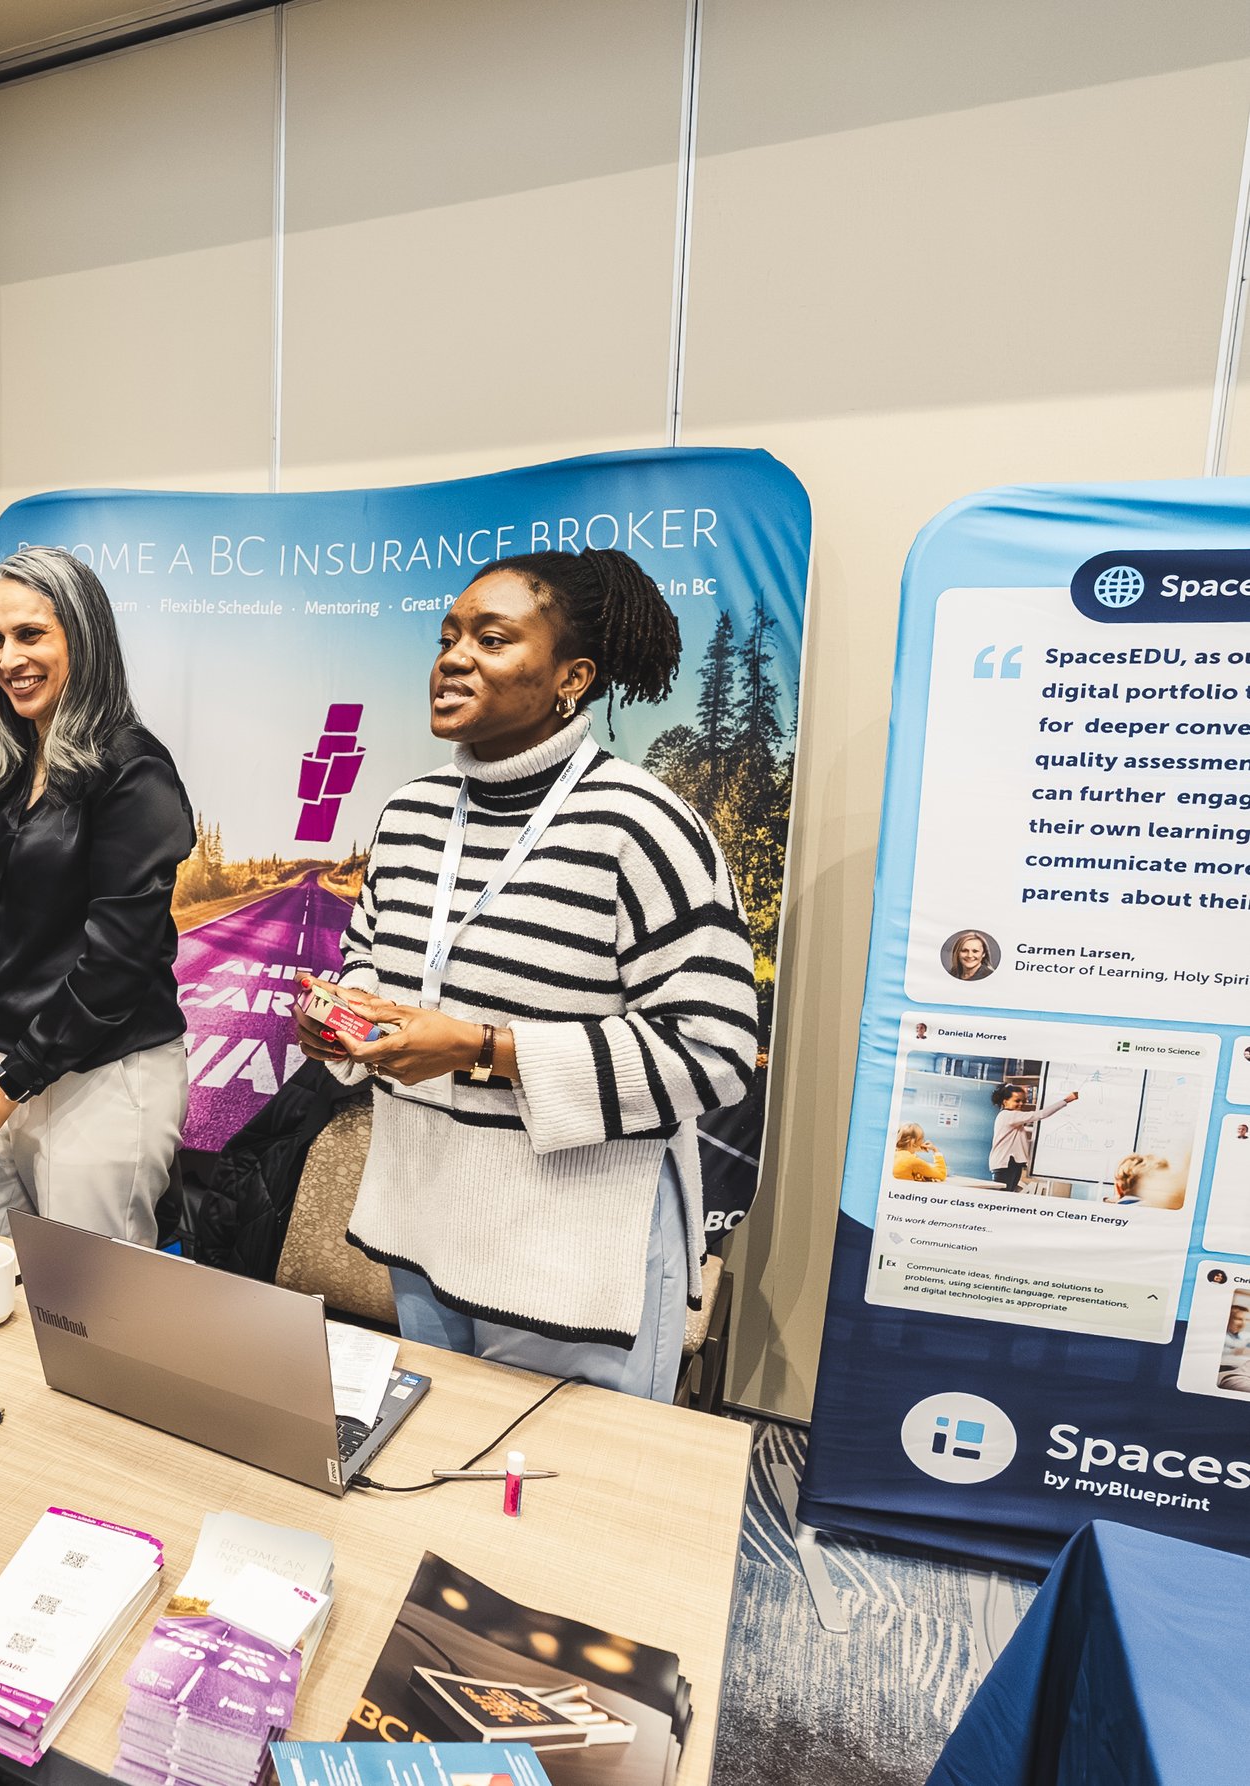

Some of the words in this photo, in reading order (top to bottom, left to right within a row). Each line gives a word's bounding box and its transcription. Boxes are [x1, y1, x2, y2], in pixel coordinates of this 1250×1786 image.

[168, 543, 194, 575] A
[210, 535, 266, 576] BC
[280, 525, 515, 576] INSURANCE
[531, 508, 718, 554] BROKER
[160, 598, 214, 614] Flexible
[217, 600, 283, 616] Schedule
[304, 599, 380, 617] Mentoring
[401, 594, 440, 612] Great
[670, 580, 687, 596] In
[692, 578, 717, 595] BC
[1045, 648, 1187, 668] SpacesEDU,
[1194, 651, 1221, 665] as
[1041, 682, 1119, 702] digital
[1125, 683, 1239, 703] portfolio
[1039, 717, 1074, 733] for
[1084, 717, 1170, 738] deeper
[1175, 721, 1250, 736] conve
[1035, 751, 1119, 772] quality
[1123, 756, 1250, 771] assessmen
[1031, 787, 1073, 801] can
[1079, 786, 1166, 804] further
[1177, 791, 1250, 810] engag
[1029, 818, 1085, 836] their
[1090, 822, 1141, 837] own
[1148, 821, 1250, 845] learning
[1025, 854, 1188, 873] communicate
[1021, 887, 1110, 904] parents
[1120, 889, 1192, 908] about
[1199, 892, 1250, 911] thei
[1016, 943, 1076, 958] Carmen
[1080, 946, 1136, 962] Larsen,
[1014, 960, 1076, 975] Director
[1078, 963, 1095, 976] of
[1098, 965, 1169, 983] Learning,
[1173, 970, 1210, 985] Holy
[1213, 972, 1250, 988] Spiri
[937, 1028, 974, 1039] Daniella
[975, 1031, 1007, 1041] Morres
[1135, 1044, 1156, 1053] Intro
[1157, 1046, 1166, 1054] to
[1167, 1046, 1201, 1057] Science
[886, 1213, 903, 1224] This
[904, 1216, 926, 1226] work
[888, 1190, 928, 1205] Leading
[930, 1197, 948, 1206] our
[950, 1197, 976, 1209] class
[977, 1202, 1038, 1217] experiment
[1039, 1208, 1054, 1218] on
[1056, 1209, 1088, 1221] Clean
[1090, 1214, 1129, 1228] Energy
[909, 1236, 979, 1252] Communication
[886, 1259, 897, 1268] Ex
[906, 1261, 967, 1278] Communicate
[967, 1269, 992, 1280] ideas,
[994, 1273, 1030, 1286] findings,
[1032, 1277, 1050, 1287] and
[1051, 1280, 1091, 1293] solutions
[1093, 1286, 1104, 1294] to
[903, 1283, 920, 1293] and
[920, 1286, 947, 1298] digital
[948, 1288, 1004, 1304] technologies
[1005, 1297, 1015, 1305] as
[1016, 1298, 1068, 1312] appropriate
[904, 1272, 947, 1286] problems,
[948, 1279, 972, 1291] using
[972, 1281, 1012, 1294] scientific
[1013, 1286, 1056, 1301] language,
[1057, 1292, 1129, 1310] representations,
[33, 1305, 88, 1338] ThinkBook
[1046, 1423, 1250, 1490] Spaces
[330, 1461, 338, 1482] Lenovo
[1043, 1470, 1070, 1490] by
[1075, 1477, 1210, 1512] myBlueprint
